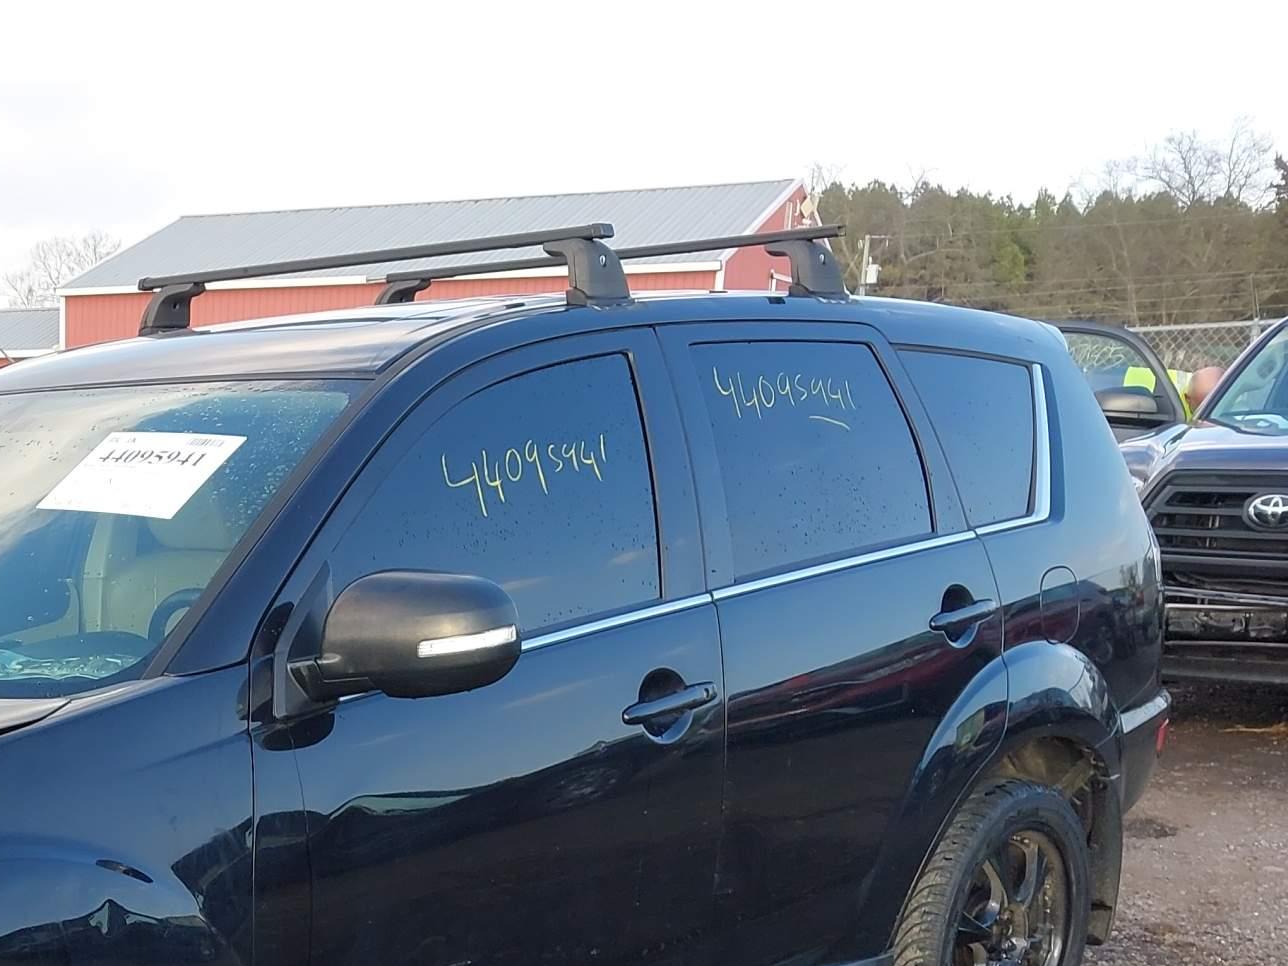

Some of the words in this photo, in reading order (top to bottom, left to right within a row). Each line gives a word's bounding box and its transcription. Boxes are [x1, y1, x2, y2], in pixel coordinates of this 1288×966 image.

[712, 365, 857, 420] 44095941
[98, 448, 208, 467] 44095941
[441, 432, 608, 518] 44095941
